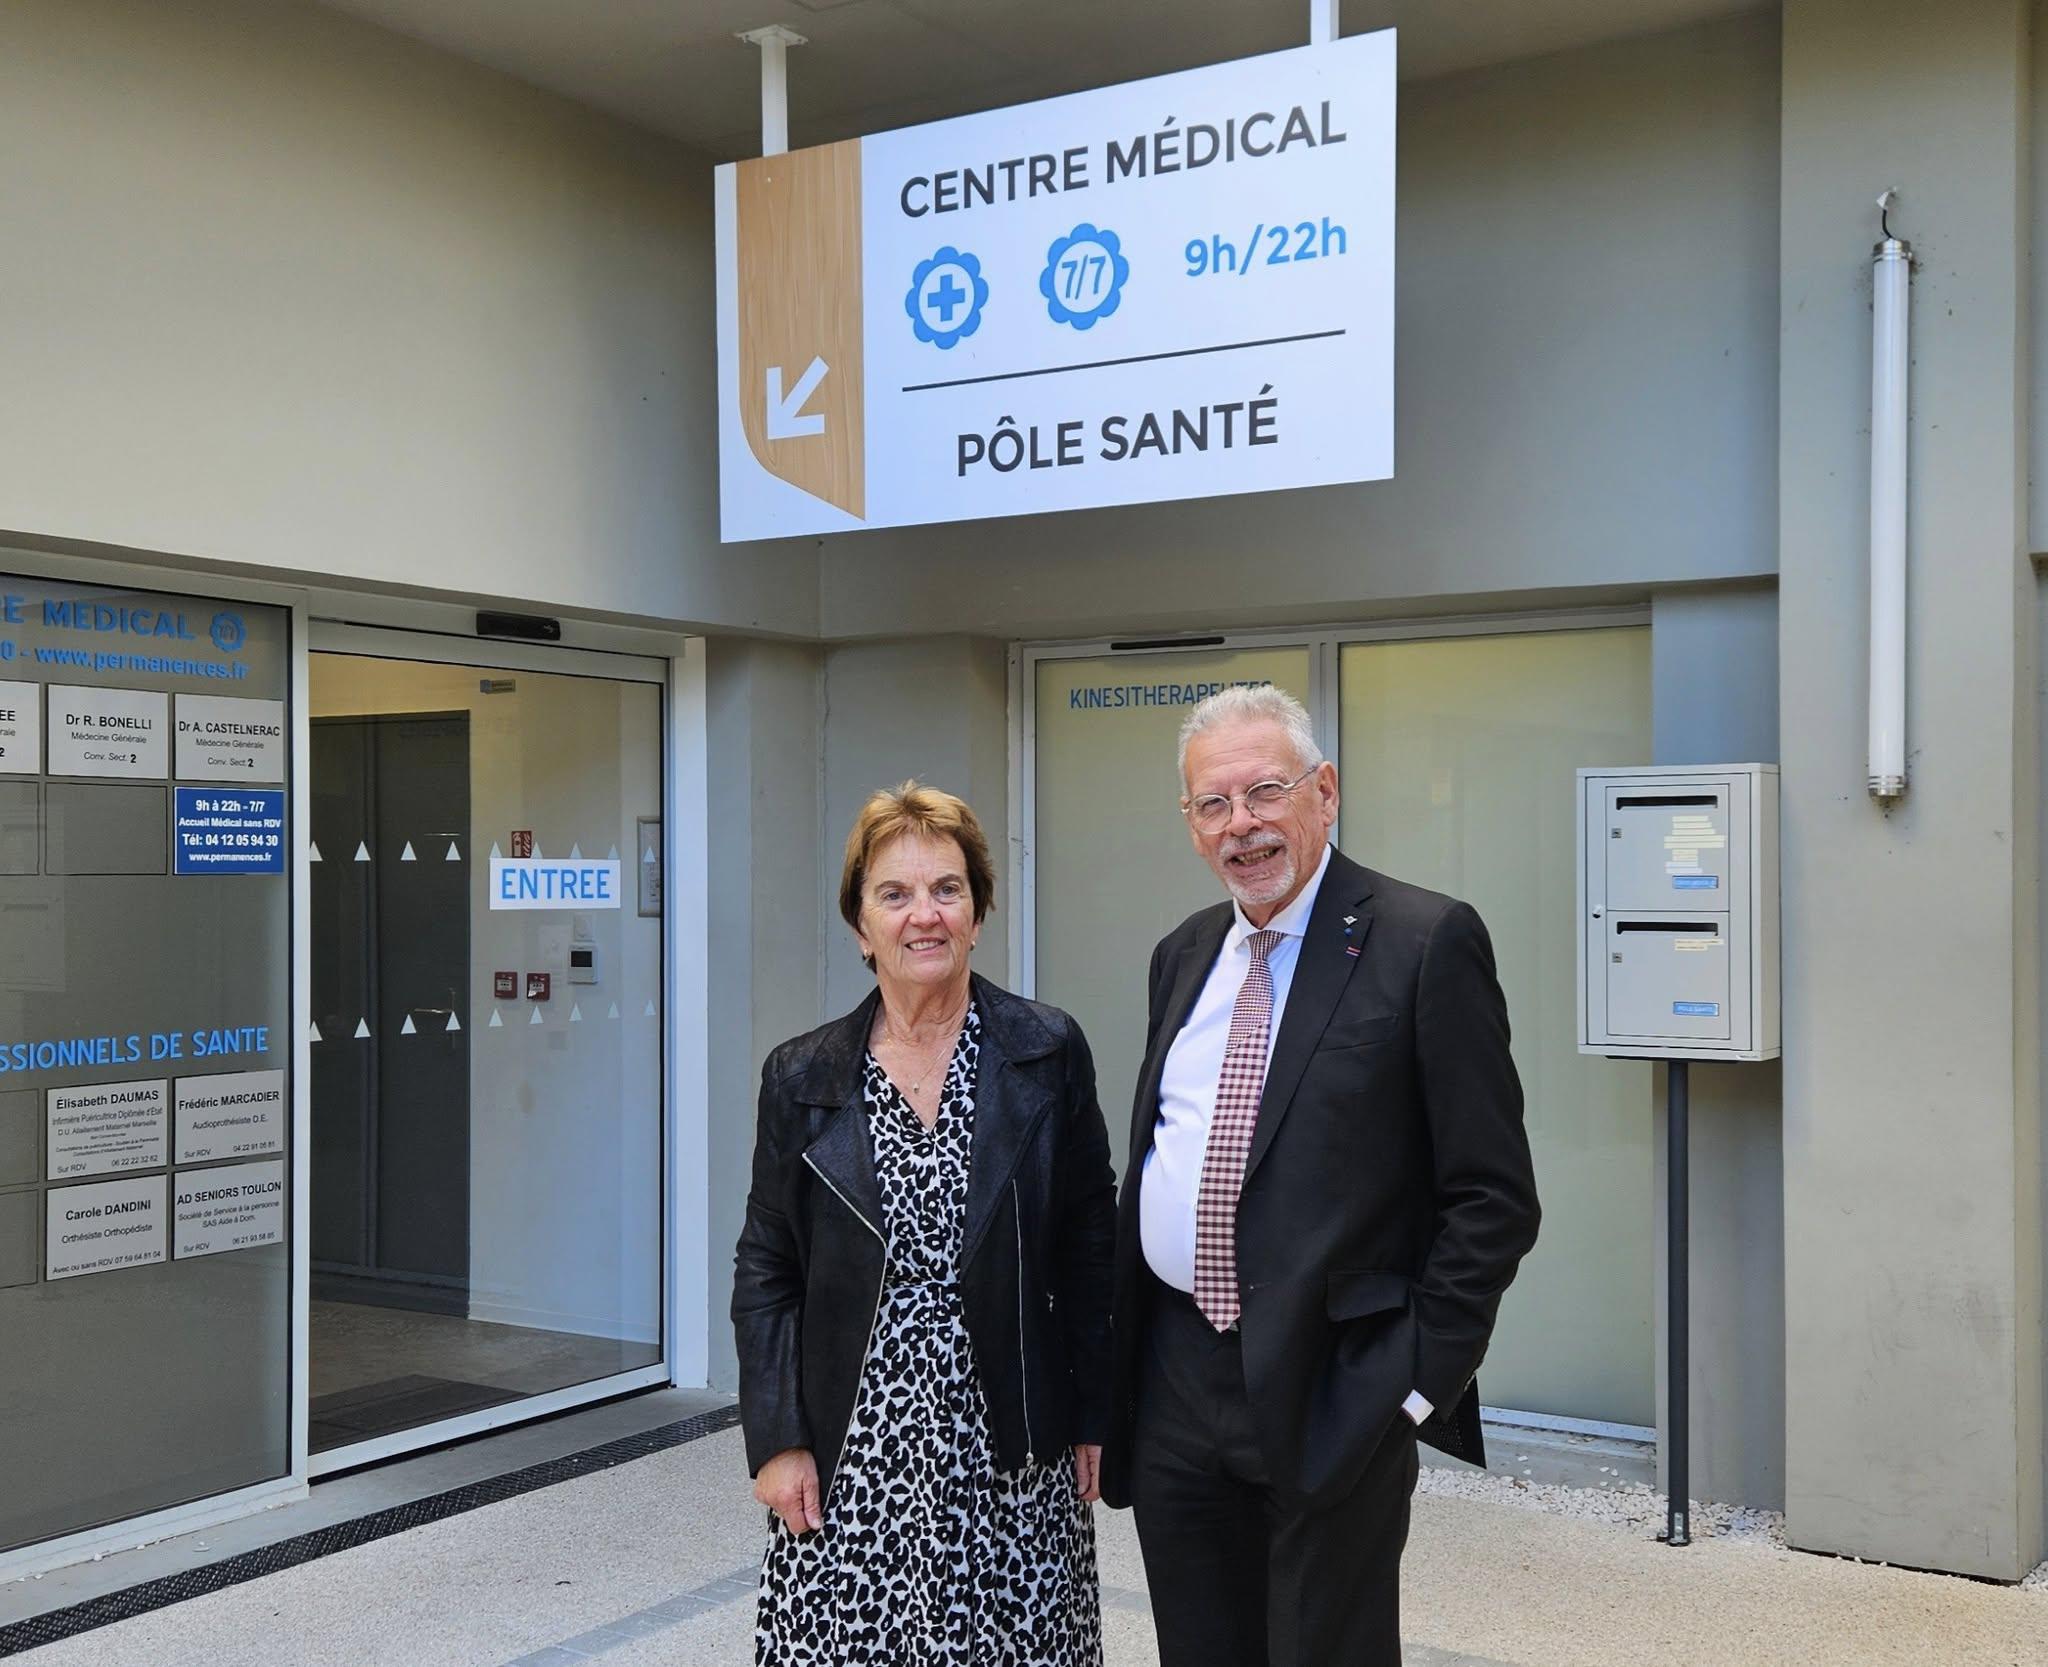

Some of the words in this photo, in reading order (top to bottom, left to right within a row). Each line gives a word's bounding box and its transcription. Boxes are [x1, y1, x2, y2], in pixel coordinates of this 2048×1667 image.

[900, 145, 1090, 219] CENTRE
[1106, 100, 1347, 184] MÉDICAL
[1184, 216, 1347, 277] 9h/22h
[1060, 253, 1107, 301] 7/7
[957, 414, 1085, 478] PÔLE
[1099, 383, 1279, 462] SANTÉ
[0, 594, 25, 625] E
[42, 599, 197, 641] MEDICAL
[34, 647, 250, 681] www.permanences.fr
[1070, 680, 1273, 709] KINESITHERAPE
[66, 713, 81, 726] Dr
[83, 715, 96, 727] R.
[99, 716, 152, 730] BONELLI
[178, 720, 191, 732] Dr
[192, 721, 204, 732] A.
[205, 722, 281, 737] CASTELNERAC
[71, 731, 110, 742] Médecine
[111, 733, 147, 744] Générale
[195, 738, 231, 748] Médecine
[232, 739, 265, 750] Générale
[130, 753, 137, 764] 2
[247, 758, 255, 768] 2
[195, 799, 210, 811] 9h
[212, 799, 219, 812] à
[221, 800, 241, 812] 22h
[249, 800, 266, 813] 7/7
[178, 816, 210, 827] Accueil
[210, 817, 242, 828] Médical
[243, 820, 262, 828] sans
[263, 818, 282, 828] RDV
[182, 832, 204, 846] Tél:
[205, 833, 219, 846] 04
[221, 833, 235, 846] 12
[236, 834, 249, 847] 05
[250, 834, 264, 847] 94
[265, 834, 279, 847] 30
[188, 851, 272, 863] www.permanences.fr
[501, 868, 611, 899] ENTREE
[0, 1034, 142, 1073] SSIONNELS
[150, 1031, 184, 1060] DE
[192, 1026, 269, 1057] SANTE
[56, 1095, 108, 1110] Élisabeth
[110, 1089, 160, 1105] DAUMAS
[178, 1096, 219, 1111] Frédéric
[220, 1090, 281, 1106] MARCADIER
[192, 1114, 251, 1131] Audioprothésiste
[176, 1192, 193, 1206] AD
[194, 1186, 239, 1203] SENIORS
[240, 1180, 282, 1196] TOULON
[65, 1206, 102, 1221] Carole
[104, 1199, 152, 1217] DANDINI
[61, 1230, 103, 1244] Orthésiste
[103, 1223, 153, 1239] Orthopédiste
